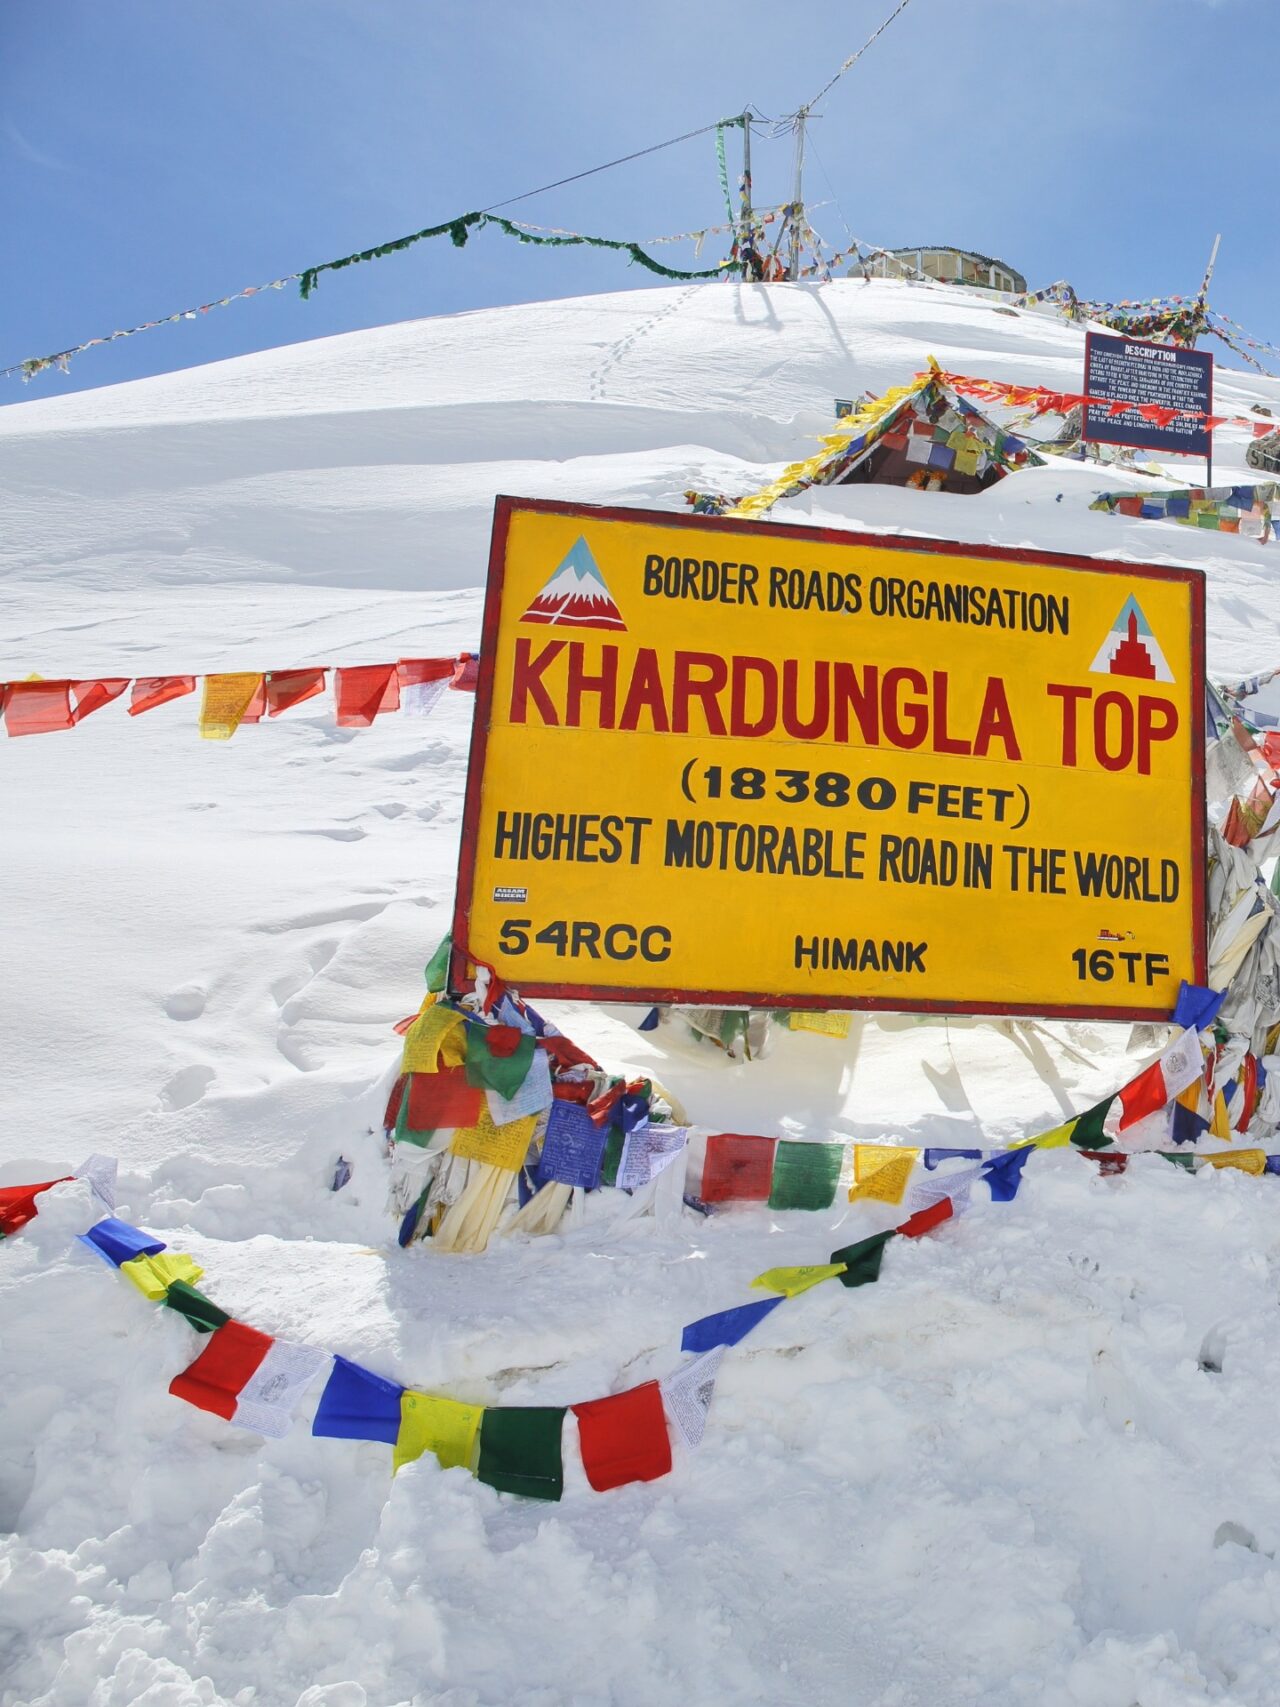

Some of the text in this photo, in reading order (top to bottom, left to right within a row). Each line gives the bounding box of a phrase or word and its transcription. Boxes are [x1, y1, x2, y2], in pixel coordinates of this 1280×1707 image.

[1125, 344, 1176, 362] DESCRIPTION
[643, 554, 1069, 635] BORDER ROADS ORGANISATION
[509, 637, 1178, 775] KHARDUNGLA TOP
[681, 758, 1030, 829] (18380 FEET)
[494, 810, 1180, 903] HIGHEST MOTORABLE ROAD IN THE WORLD
[794, 935, 928, 972] HIMANK
[1071, 948, 1170, 986] 16TF
